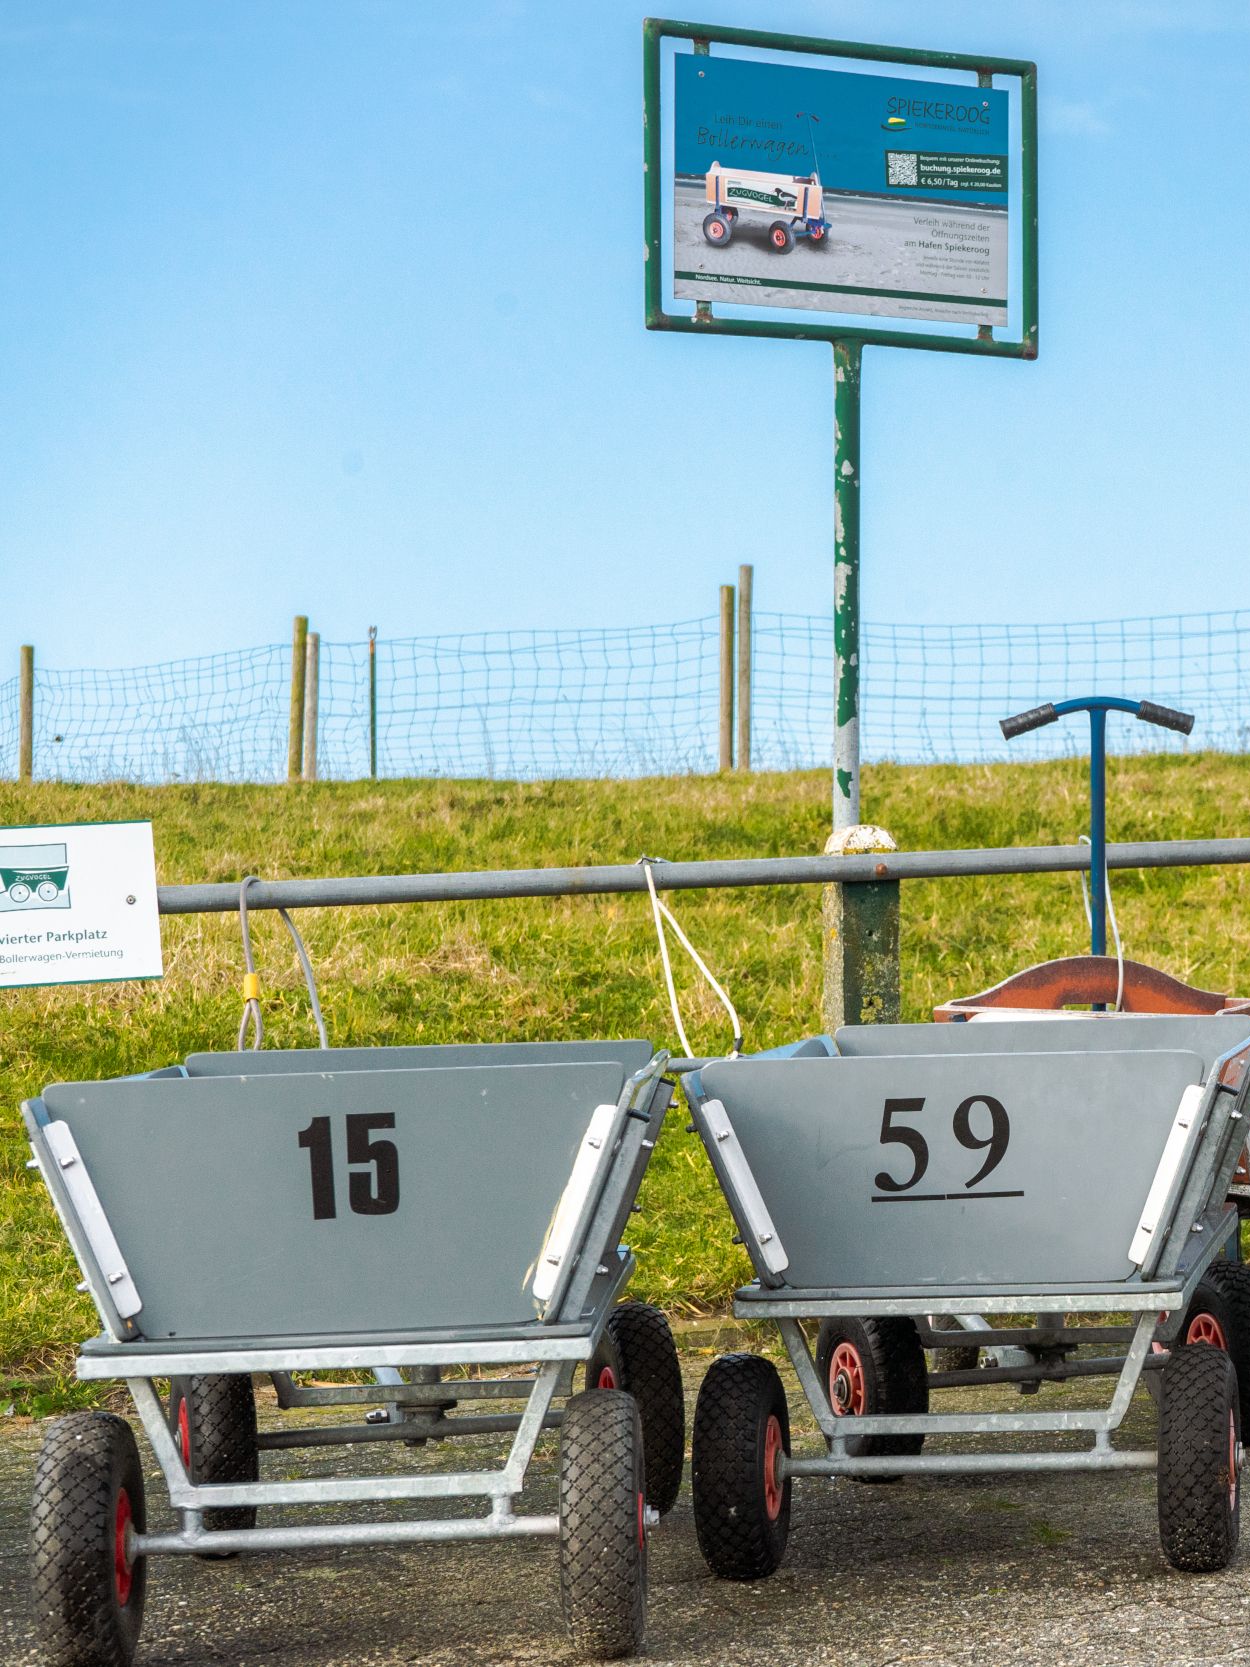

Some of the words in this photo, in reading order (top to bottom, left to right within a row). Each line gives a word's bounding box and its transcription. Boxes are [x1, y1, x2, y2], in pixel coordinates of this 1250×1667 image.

[887, 96, 991, 125] SPIEKEROOG
[714, 112, 735, 125] Leih
[738, 115, 753, 127] Dir
[755, 118, 783, 130] einen
[697, 126, 810, 162] Bollerwagen
[920, 163, 1001, 176] buchung.spiekeroog.de
[729, 188, 774, 203] ZUGVOGEL
[913, 216, 940, 227] Verleih
[942, 220, 976, 231] während
[977, 223, 990, 232] der
[931, 229, 990, 243] Öffnungszeiten
[918, 240, 943, 250] Hafen
[944, 242, 990, 257] Spiekeroog
[15, 874, 52, 882] ZUGVOGEL
[46, 929, 108, 944] Parkplatz
[874, 1094, 1011, 1193] 59
[298, 1112, 400, 1220] 15
